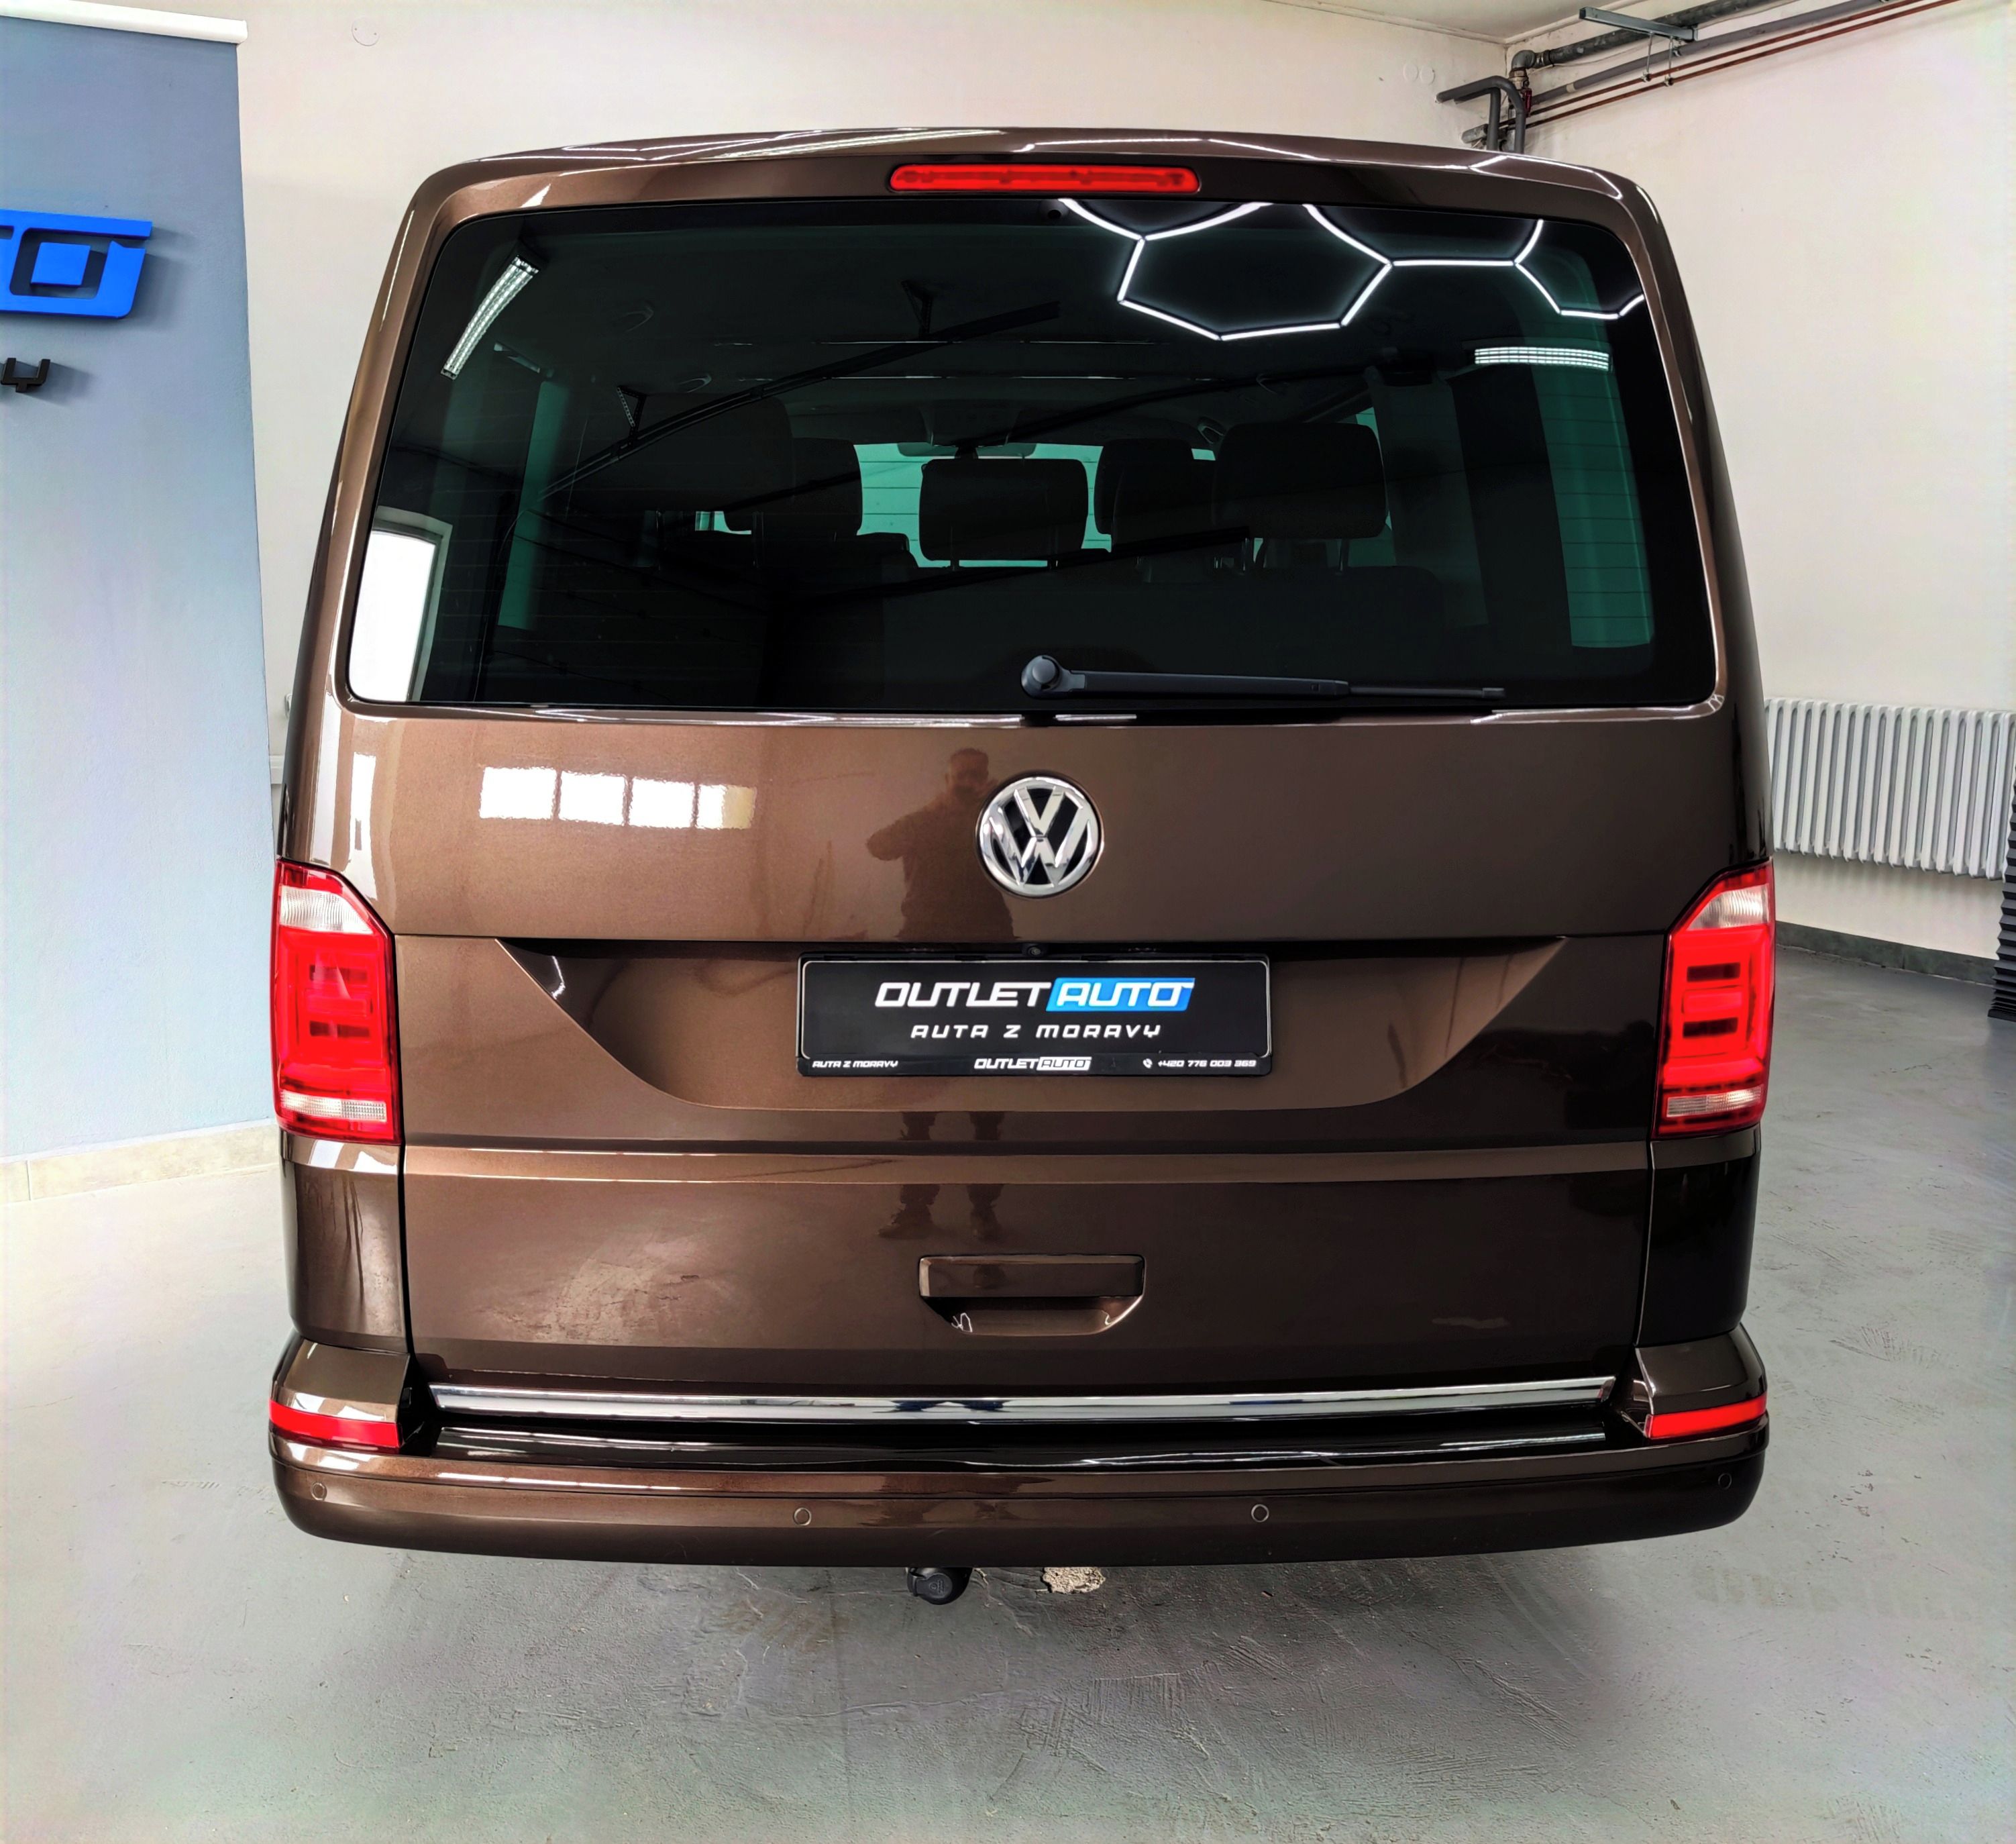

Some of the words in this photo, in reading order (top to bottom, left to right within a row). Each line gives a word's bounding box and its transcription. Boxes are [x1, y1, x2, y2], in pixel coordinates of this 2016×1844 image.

[910, 1025, 989, 1039] AUTA
[1003, 1024, 1021, 1038] Z
[1035, 1024, 1161, 1038] MORAVY
[812, 1060, 842, 1068] AUTA
[843, 1060, 851, 1068] Z
[852, 1060, 899, 1068] MORAVY
[1157, 1060, 1185, 1068] +420
[1187, 1060, 1208, 1068] 776
